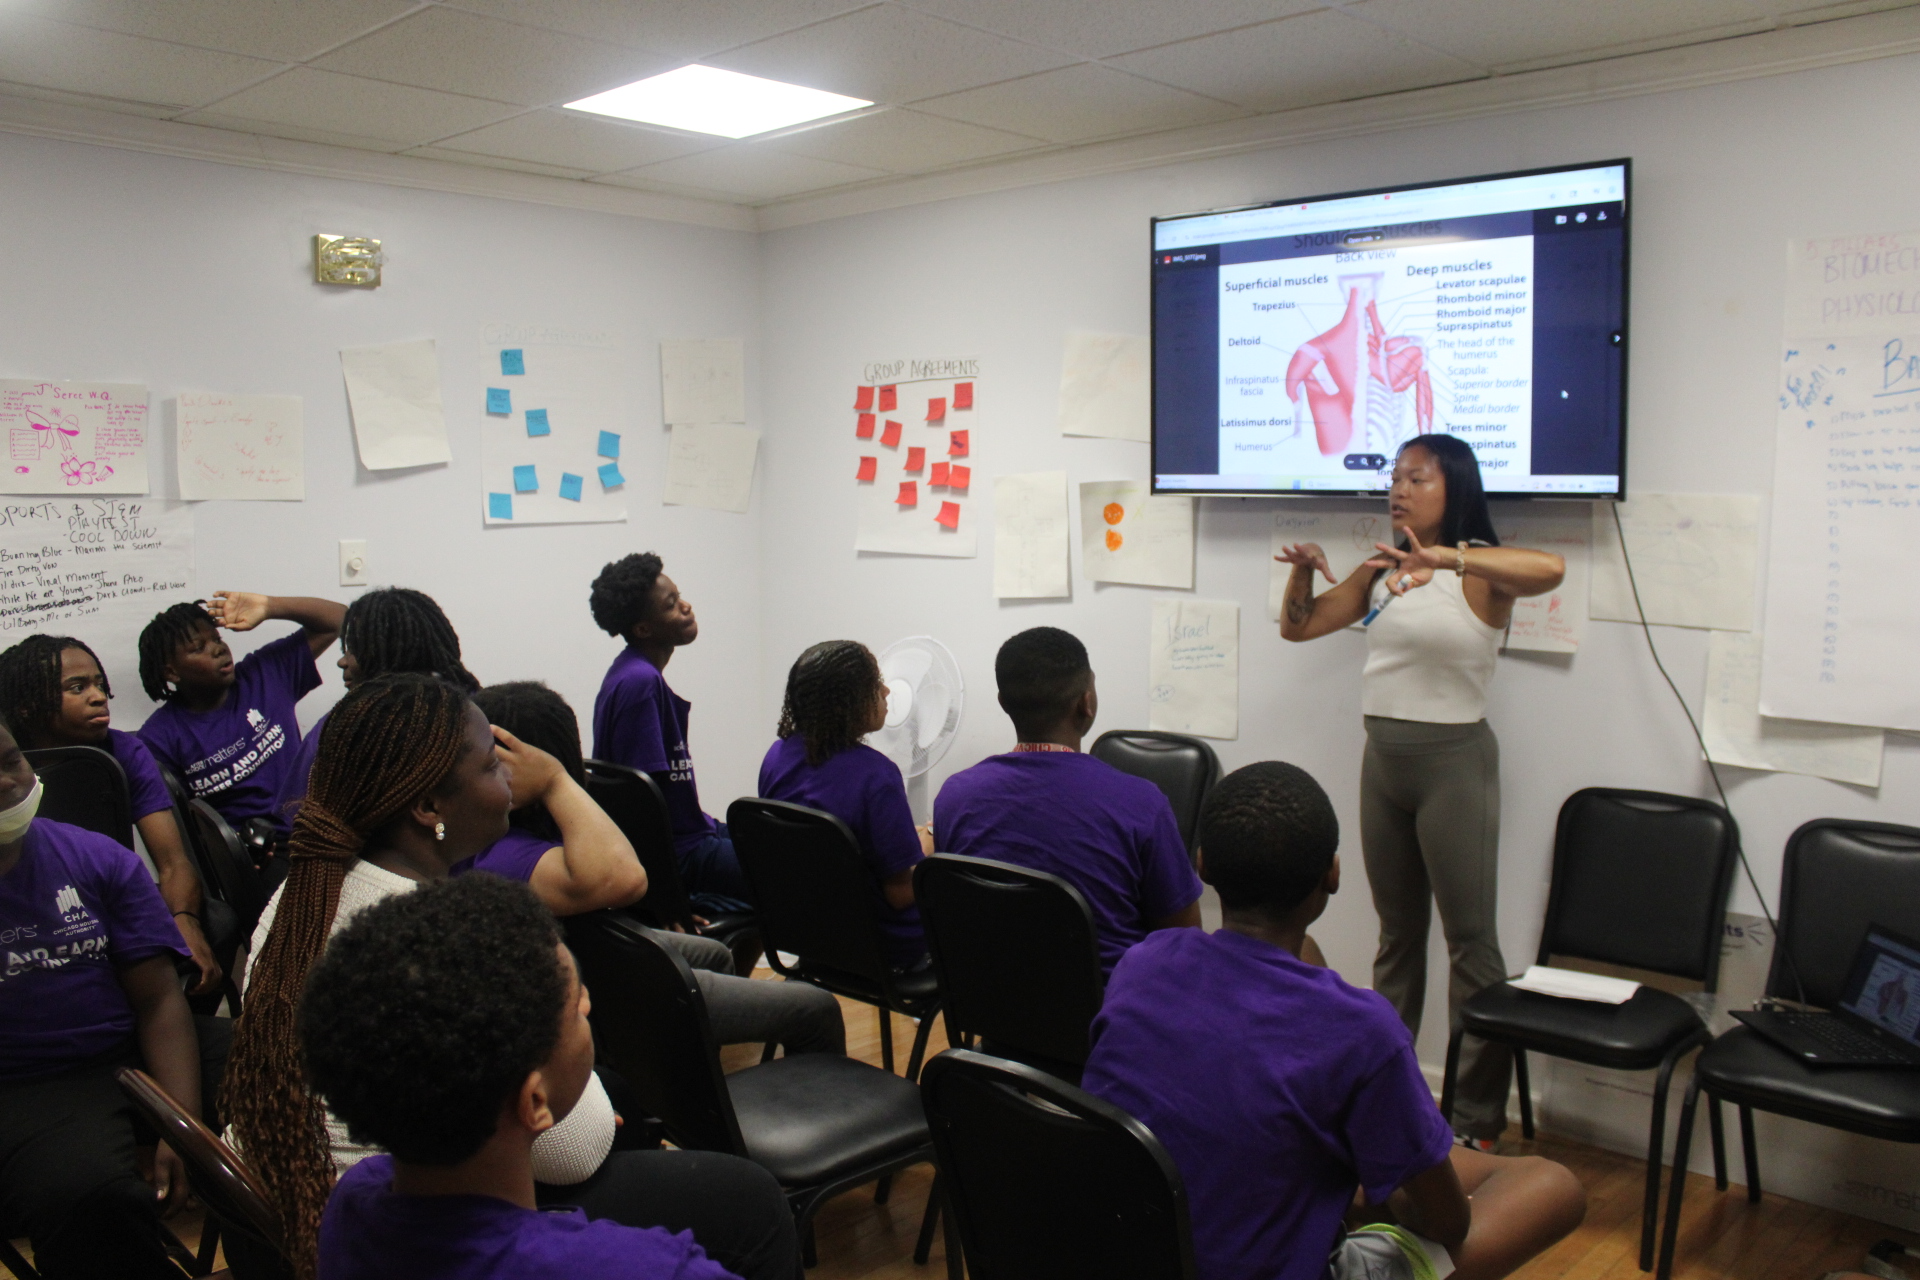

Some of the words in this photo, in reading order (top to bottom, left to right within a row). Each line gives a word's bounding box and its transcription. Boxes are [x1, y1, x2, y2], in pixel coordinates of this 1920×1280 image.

[1294, 231, 1356, 249] Shoul
[1378, 221, 1442, 239] uscles
[1335, 251, 1364, 264] Back
[1367, 249, 1397, 261] view
[1406, 264, 1439, 277] Deep
[1442, 260, 1493, 274] muscles
[1225, 276, 1282, 293] Superficial
[1284, 273, 1329, 286] muscles
[1436, 278, 1476, 290] Levator
[1479, 274, 1527, 288] scapulae
[1437, 292, 1492, 304] Rhomboid
[1495, 290, 1527, 301] minor
[1252, 301, 1296, 312] Trapezius
[1437, 306, 1492, 319] Rhomboid
[1495, 305, 1527, 317] major
[1437, 319, 1513, 332] Supraspinatus
[1228, 336, 1261, 347] Deltoid
[1438, 339, 1455, 349] The
[1457, 338, 1484, 348] head
[1487, 337, 1498, 347] of
[1500, 336, 1515, 347] the
[1453, 349, 1498, 360] humerus
[864, 360, 904, 382] GROUP
[910, 359, 980, 378] AGREEMENTS
[1448, 366, 1489, 377] Scapula:
[1225, 375, 1279, 386] Infraspinatus
[1453, 379, 1494, 390] Superior
[1496, 378, 1528, 388] border
[1240, 386, 1264, 396] fascia
[1453, 393, 1480, 403] Spine
[1453, 404, 1486, 414] Medial
[1487, 404, 1520, 414] border
[1220, 417, 1267, 428] Latissimus
[1269, 417, 1292, 427] dorsi
[1446, 423, 1472, 433] Teres
[1475, 422, 1507, 432] minor
[1235, 442, 1273, 452] Humerus
[1470, 439, 1517, 450] spinatus
[1478, 458, 1509, 470] major
[92, 498, 142, 517] STEM
[42, 546, 63, 557] Blue
[189, 768, 231, 791] LEARN
[232, 750, 258, 774] AND
[64, 910, 89, 923] CHA
[53, 923, 79, 935] CHICAGO
[0, 924, 38, 948] ers
